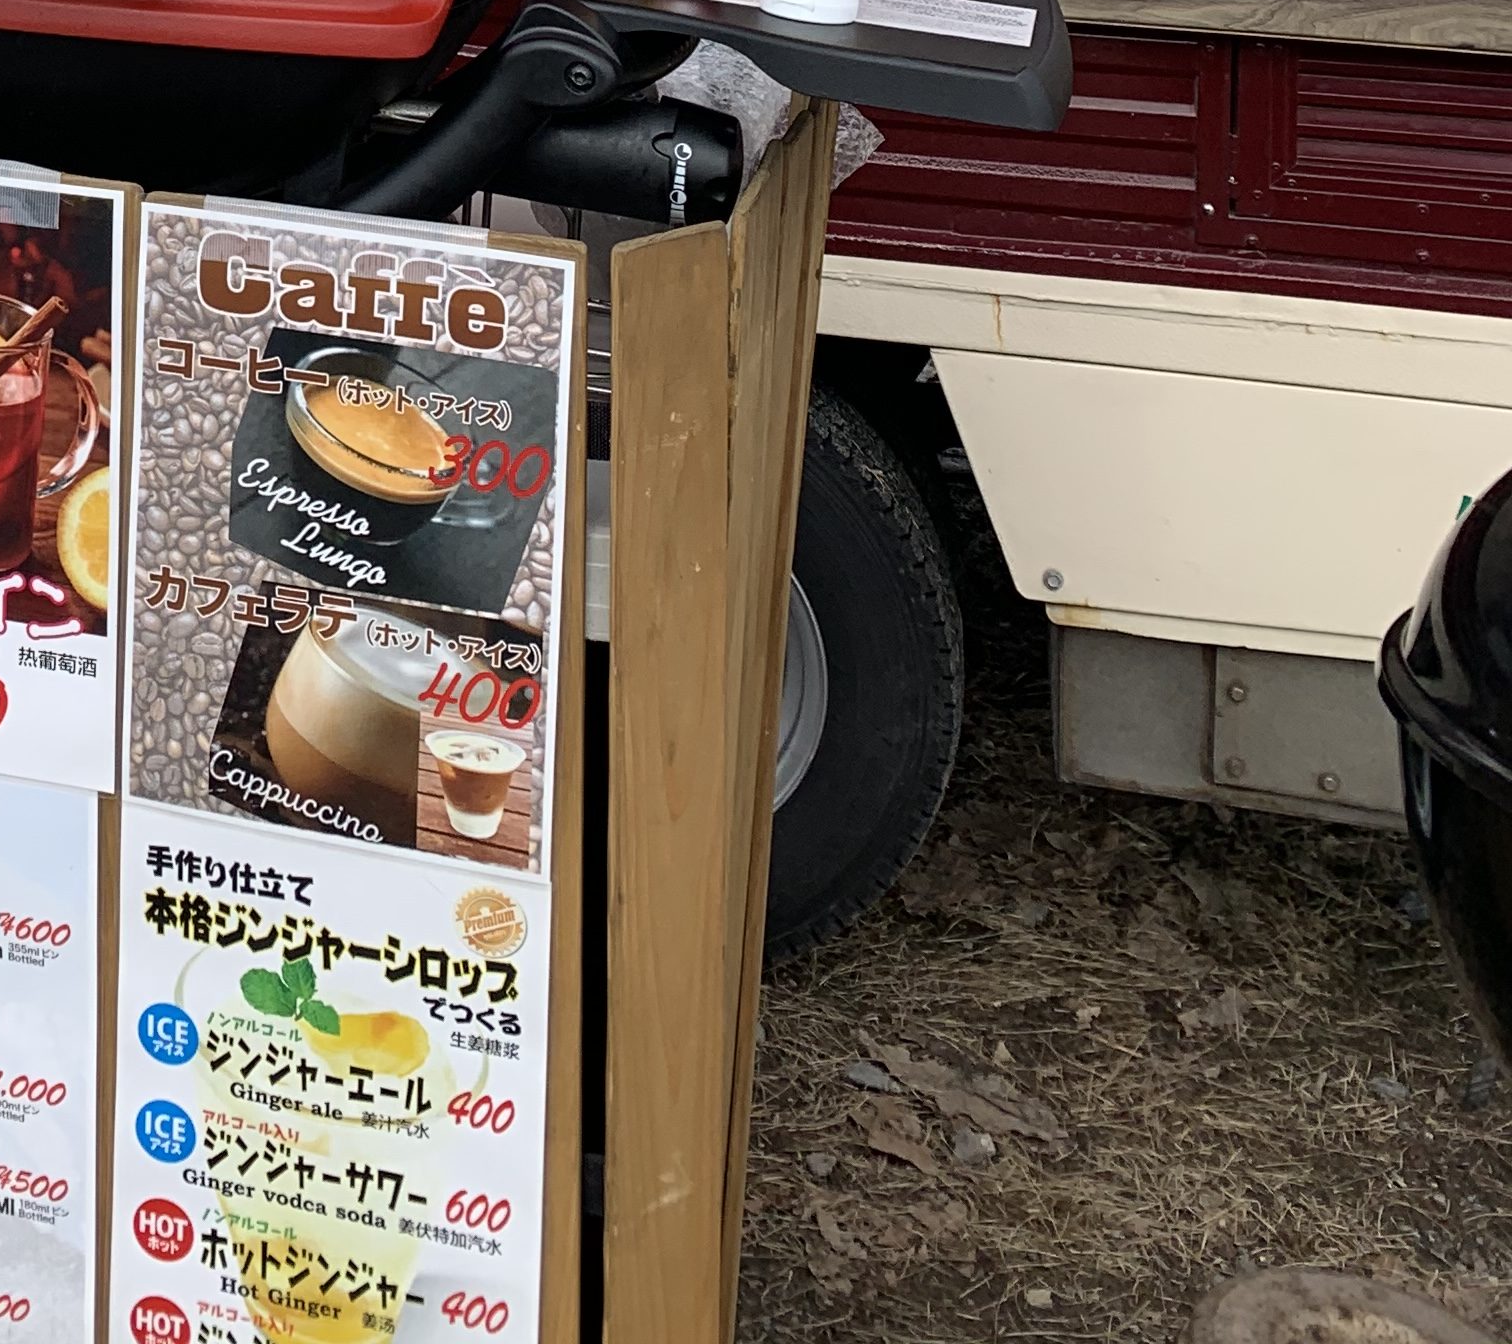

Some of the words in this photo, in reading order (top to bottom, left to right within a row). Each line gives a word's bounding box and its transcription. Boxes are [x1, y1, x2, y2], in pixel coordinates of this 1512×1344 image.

[197, 230, 508, 352] Caffè
[237, 457, 371, 538] Espresso
[427, 434, 551, 500] 300
[279, 522, 388, 588] Lungo
[17, 646, 98, 678] 热葡萄酒
[417, 661, 542, 731] 400
[207, 748, 385, 845] Cappuccino
[145, 844, 314, 906] 手作り仕立て
[143, 887, 521, 1004] 本格ジンジャーシロップ
[205, 1028, 433, 1117] ジンジャーエール
[447, 1090, 516, 1133] 400
[202, 1126, 428, 1212] ジンジャーサワー
[444, 1189, 512, 1234] 600
